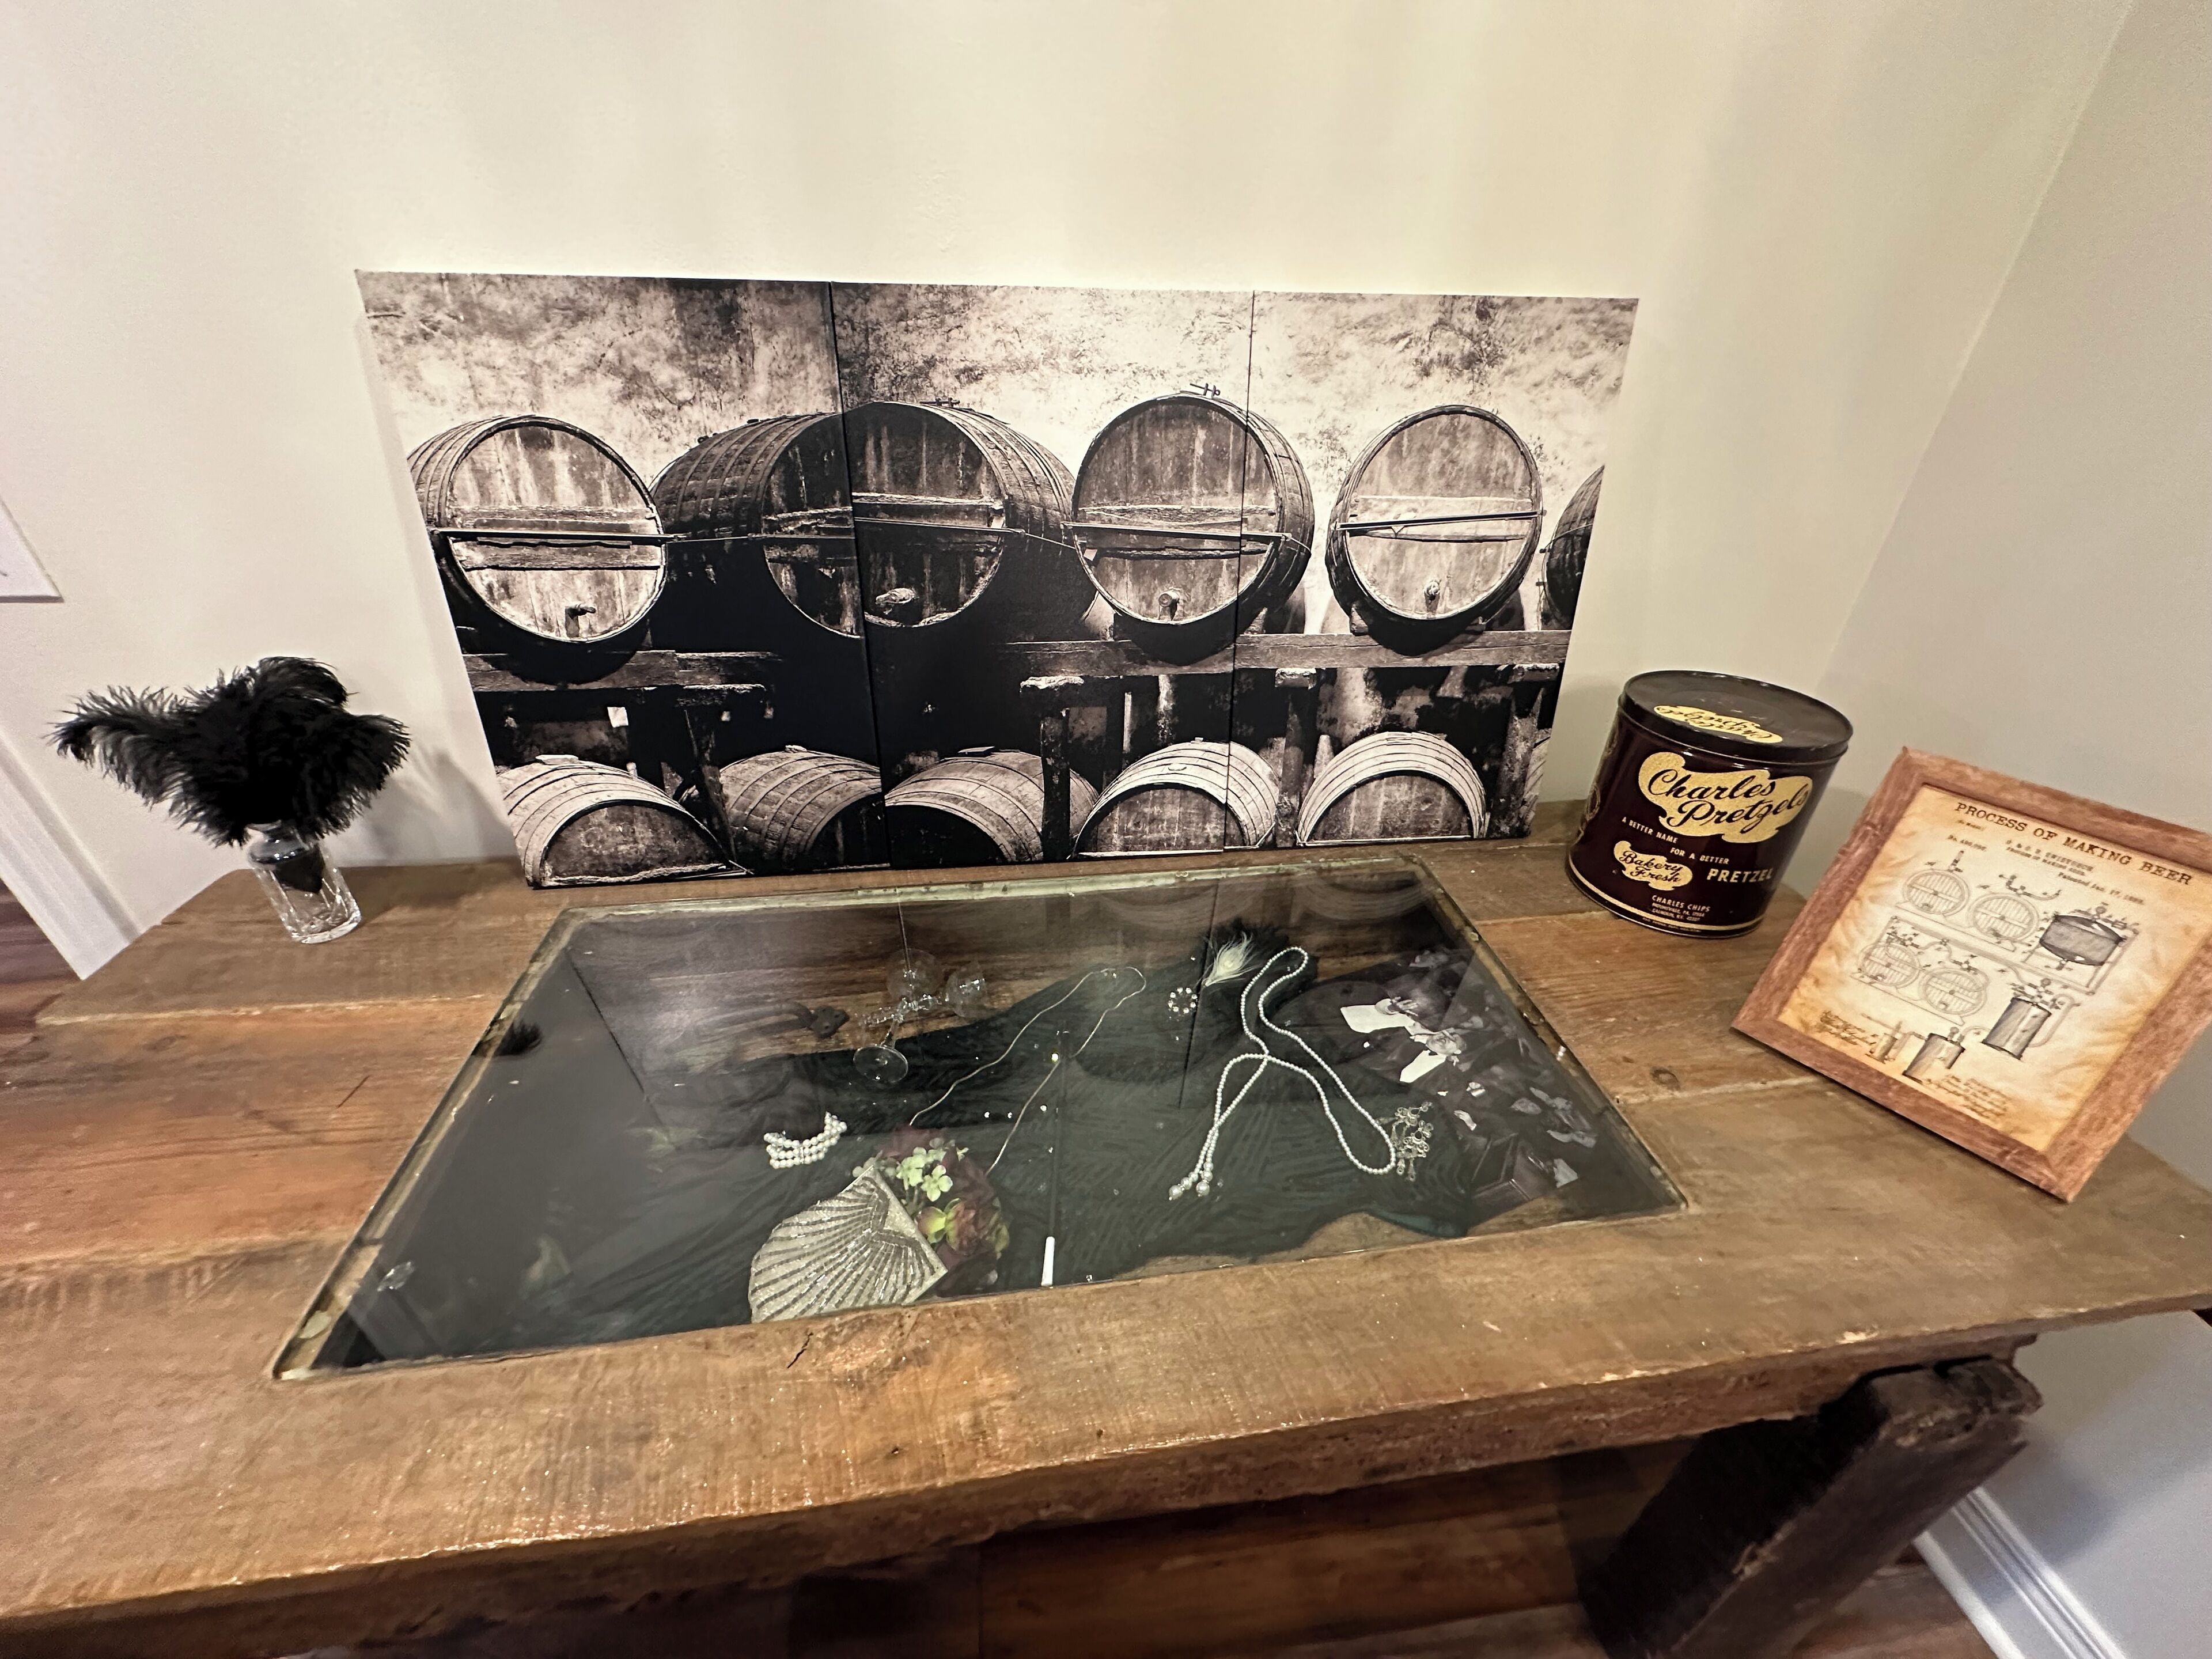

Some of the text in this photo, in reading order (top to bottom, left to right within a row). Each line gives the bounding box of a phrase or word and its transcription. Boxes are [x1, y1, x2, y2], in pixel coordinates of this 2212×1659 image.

[1647, 768, 1776, 800] Charles
[1666, 783, 1809, 835] Pretzels
[1628, 820, 1653, 835] BETTER
[1656, 832, 1679, 844] NAME
[1955, 802, 2028, 832] PROCESS
[2033, 827, 2058, 841] OF
[2062, 836, 2132, 865] MAKING
[2138, 861, 2193, 885] BEER
[1619, 850, 1684, 874] Bakery
[1670, 847, 1685, 857] FOR
[1699, 855, 1730, 865] BETTER
[1630, 866, 1681, 883] Fresh
[1706, 868, 1774, 884] PRETZEL
[1652, 895, 1711, 912] CHARLES CHIPS
